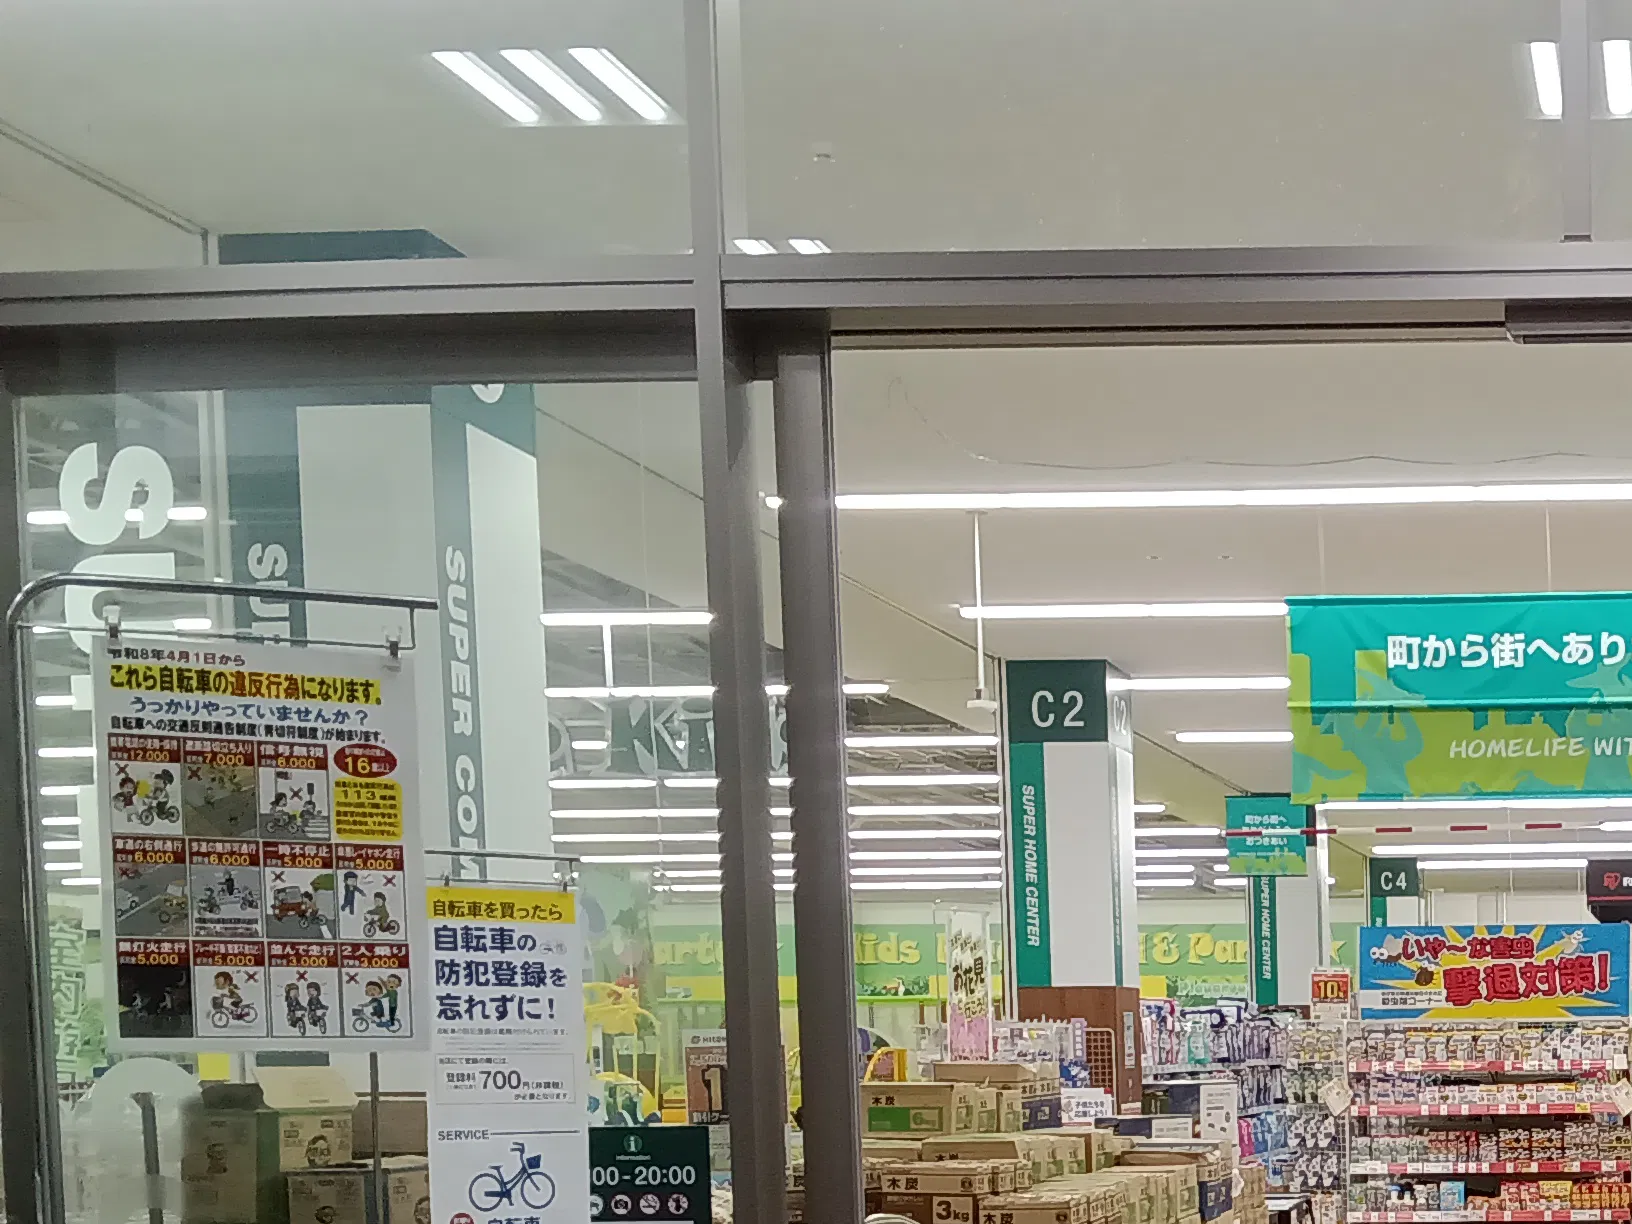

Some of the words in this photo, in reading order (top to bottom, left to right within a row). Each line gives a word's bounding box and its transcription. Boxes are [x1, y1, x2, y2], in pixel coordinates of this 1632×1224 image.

[445, 546, 473, 738] SUPER
[110, 665, 382, 705] これら自転車の違反行為になります。
[1032, 690, 1085, 729] C2
[1449, 732, 1585, 760] HOMELIFE
[1021, 784, 1036, 832] SUPER
[1024, 836, 1038, 881] HOME
[1381, 871, 1407, 891] C4
[432, 900, 563, 920] 自転車を買ったら
[1026, 886, 1041, 947] CENTER
[434, 925, 536, 953] 自転車の
[435, 959, 567, 988] 防犯登録を
[872, 1095, 896, 1106] 木炭
[438, 1129, 490, 1141] SERVICE
[887, 1177, 919, 1190] 木炭
[936, 1200, 970, 1222] 3kg
